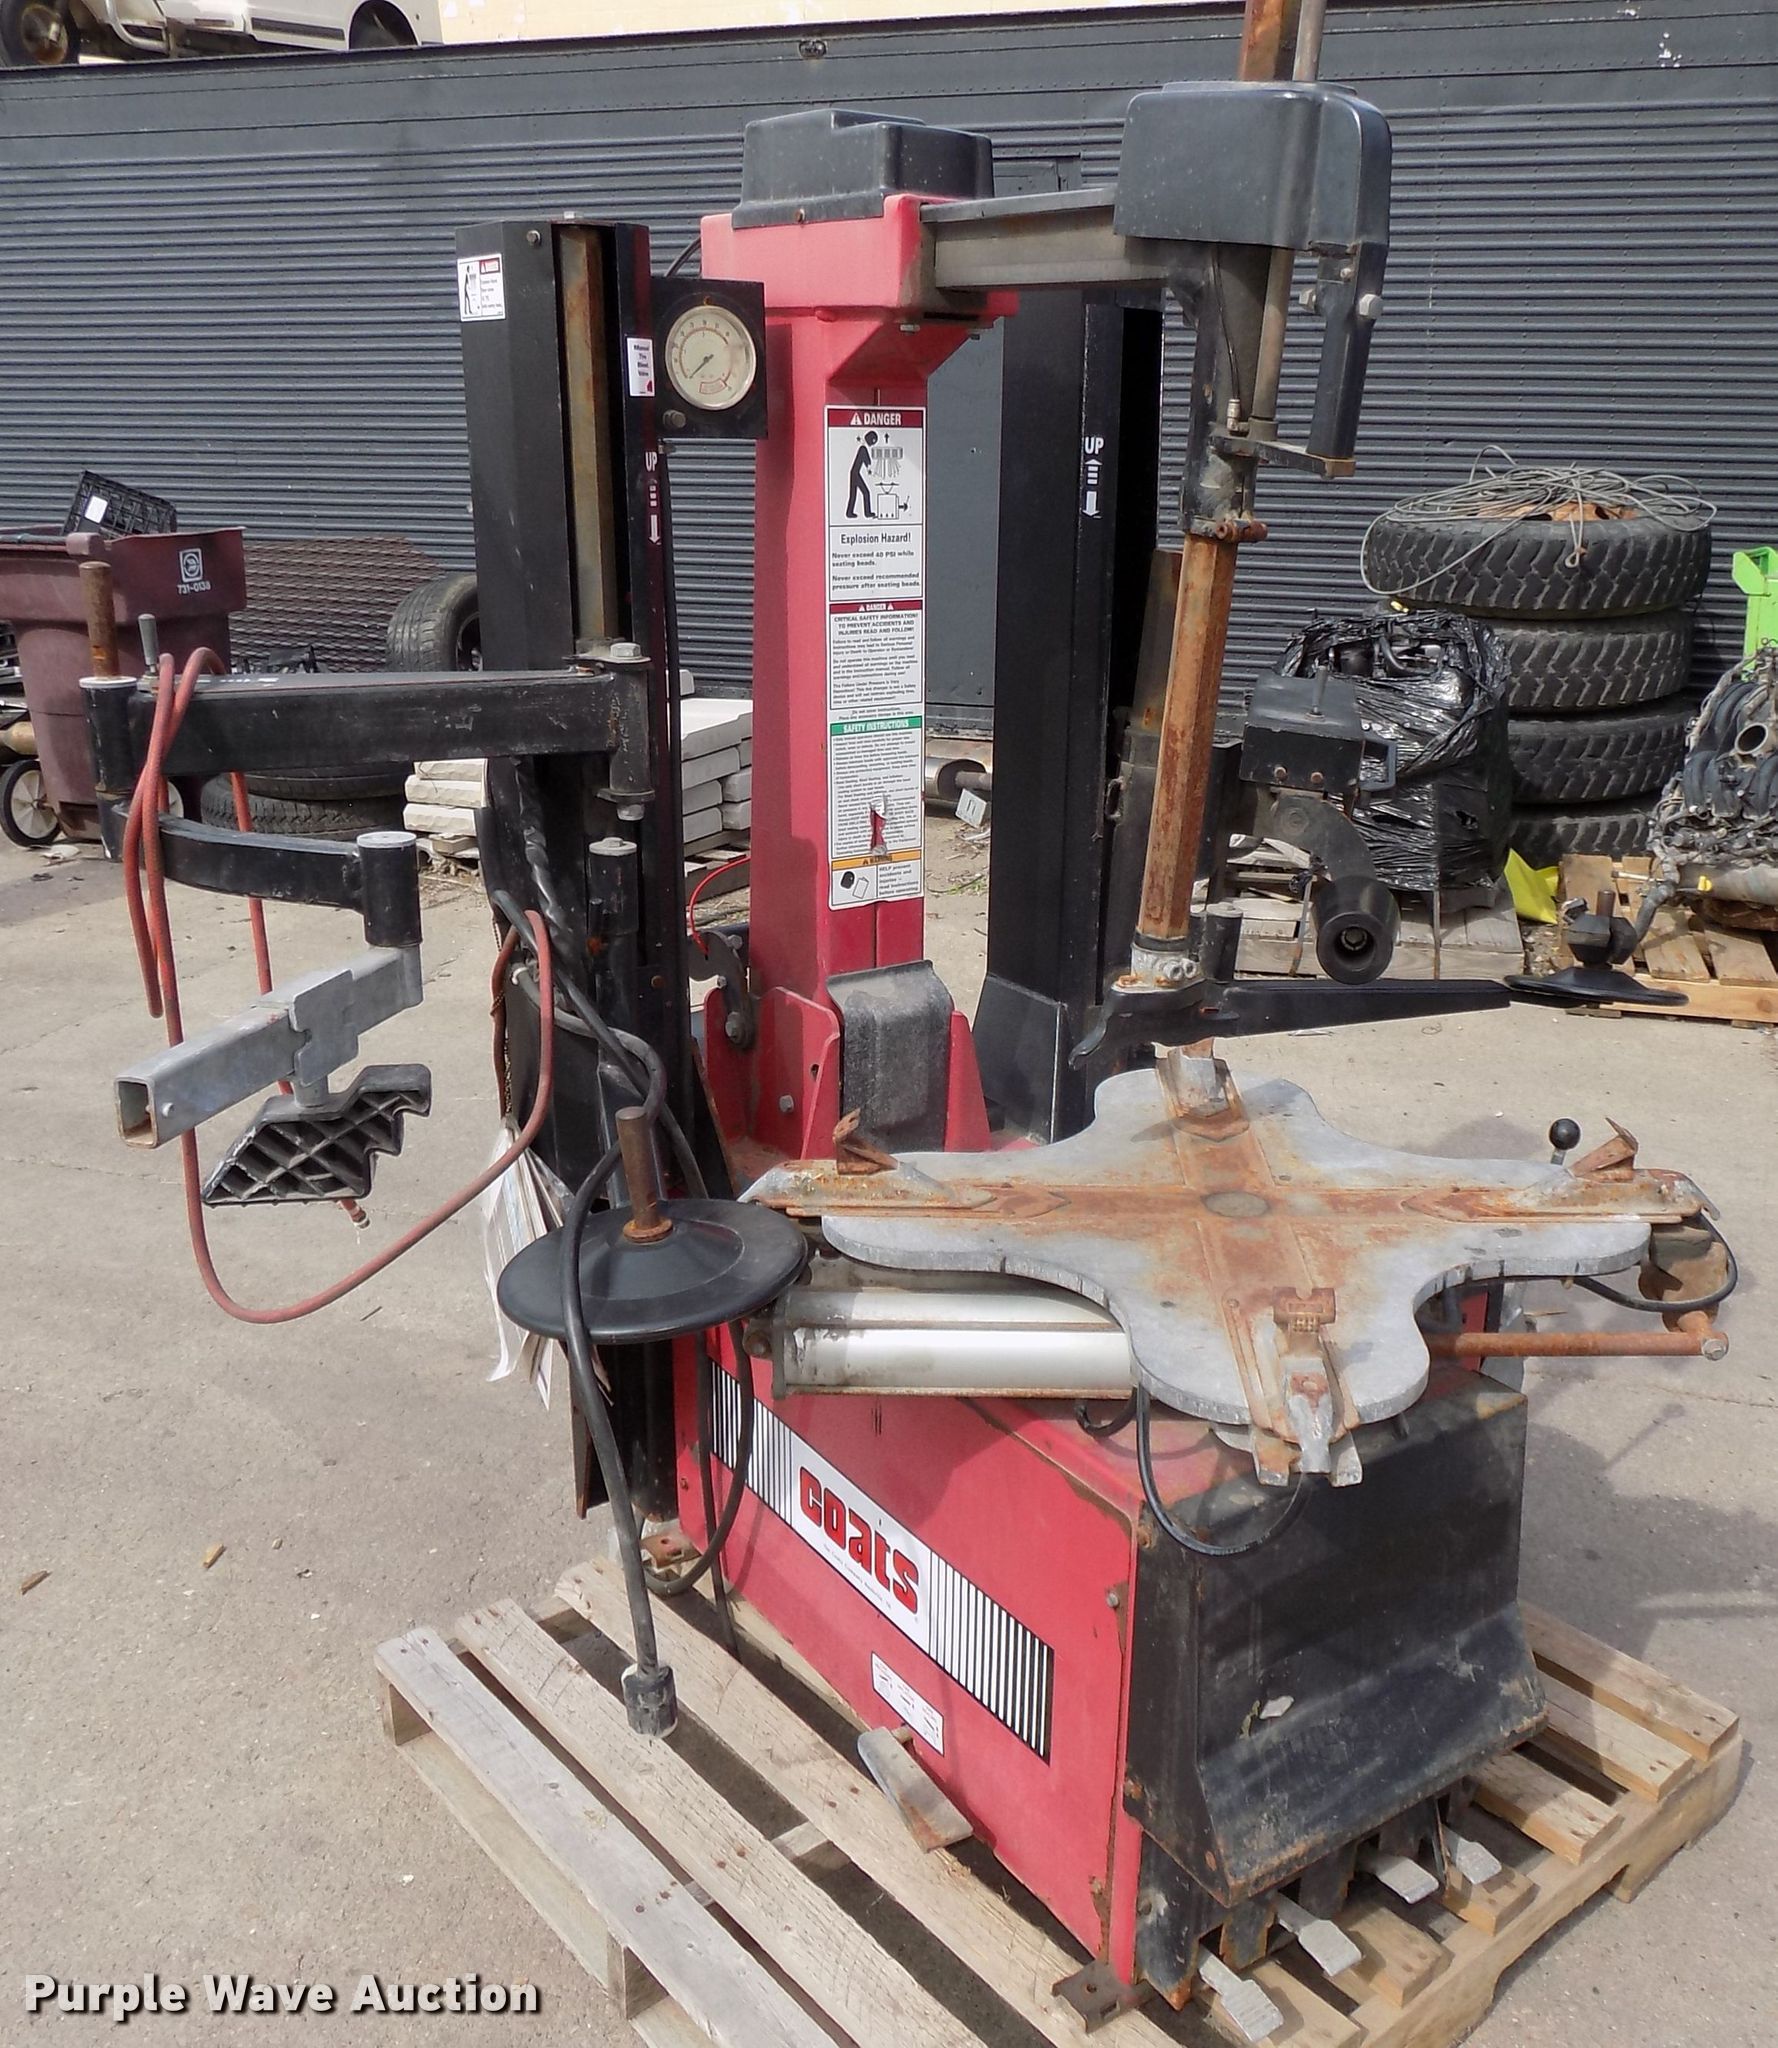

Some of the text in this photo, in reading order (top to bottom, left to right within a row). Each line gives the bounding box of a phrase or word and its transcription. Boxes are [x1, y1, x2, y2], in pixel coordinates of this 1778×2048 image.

[864, 413, 901, 425] DANGER
[1084, 436, 1104, 455] UP
[645, 451, 658, 472] UP
[841, 532, 911, 546] Explosion Hazard!
[843, 719, 909, 733] SAFETY INSTRUCTIONS
